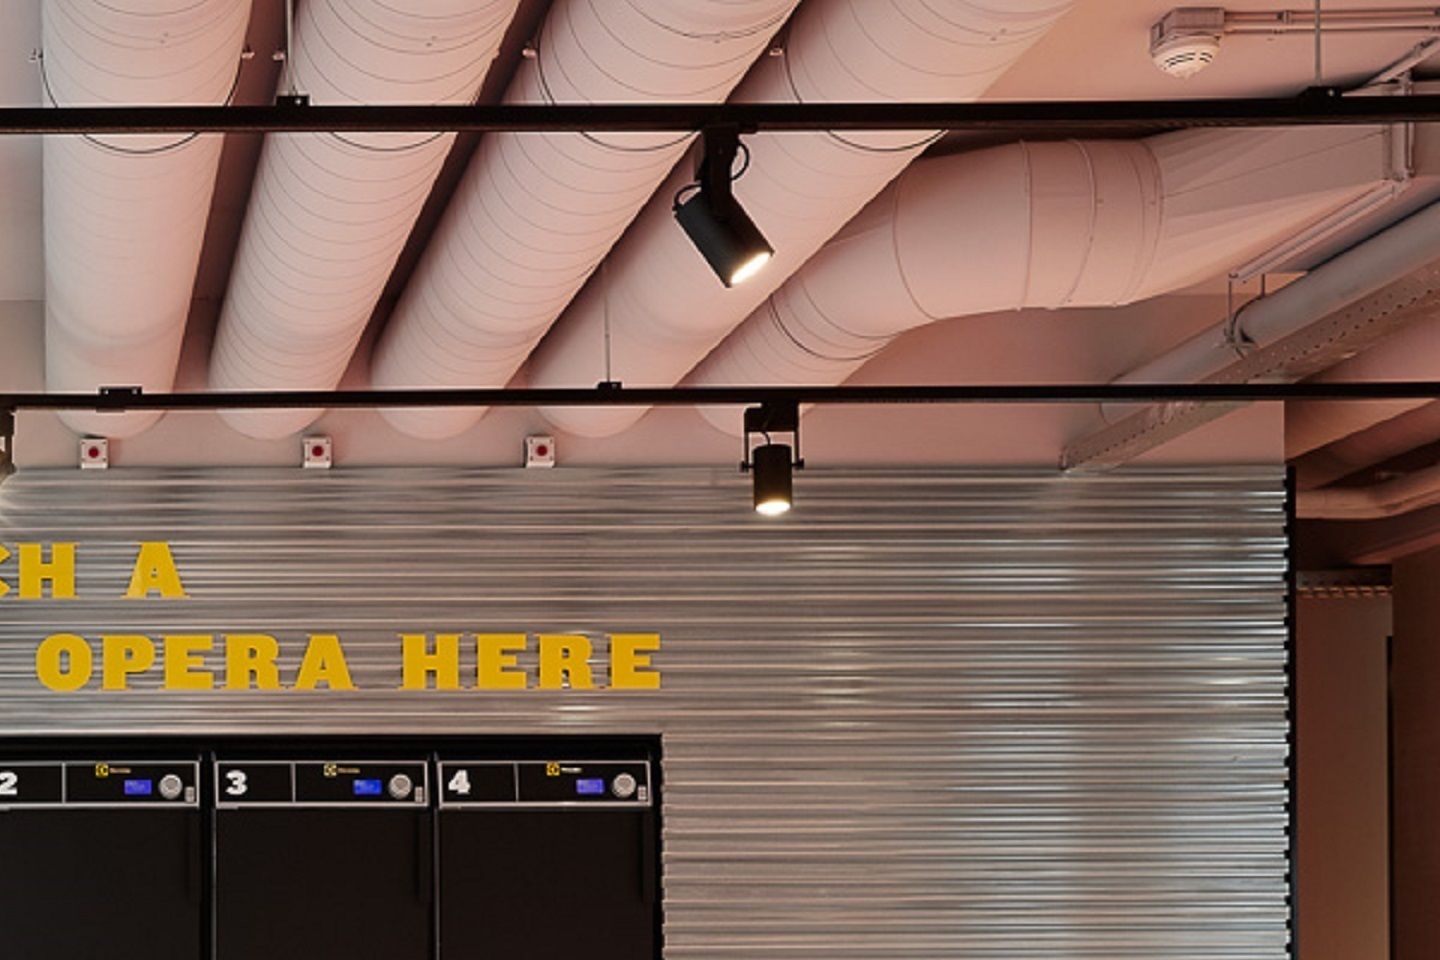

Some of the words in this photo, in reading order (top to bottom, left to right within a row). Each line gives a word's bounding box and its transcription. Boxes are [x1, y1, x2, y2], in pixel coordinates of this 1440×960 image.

[124, 540, 190, 600] A
[35, 632, 356, 692] OPERA
[400, 632, 662, 691] HERE
[225, 770, 248, 796] 3
[447, 769, 471, 795] 4
